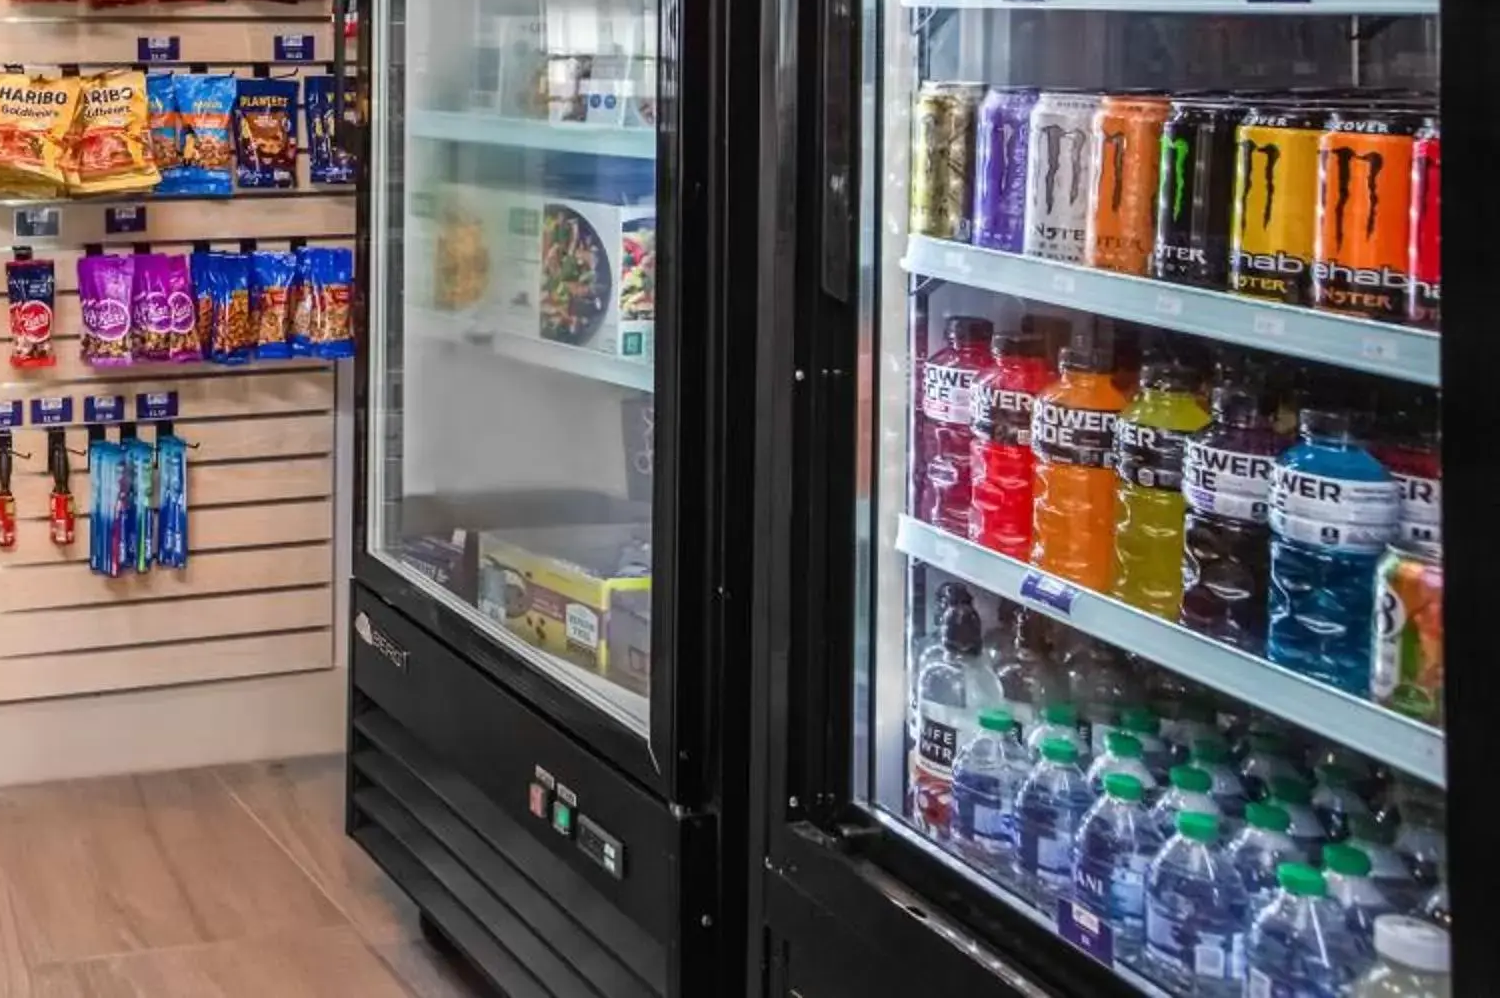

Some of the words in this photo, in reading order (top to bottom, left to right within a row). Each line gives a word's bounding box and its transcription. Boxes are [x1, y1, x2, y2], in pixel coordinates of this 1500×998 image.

[1230, 251, 1303, 274] hab
[1311, 259, 1406, 288] ehab
[1238, 276, 1288, 294] STER
[1325, 285, 1393, 310] NSTER
[977, 385, 1036, 412] WER
[1189, 446, 1273, 480] OWER
[1278, 471, 1342, 503] WER
